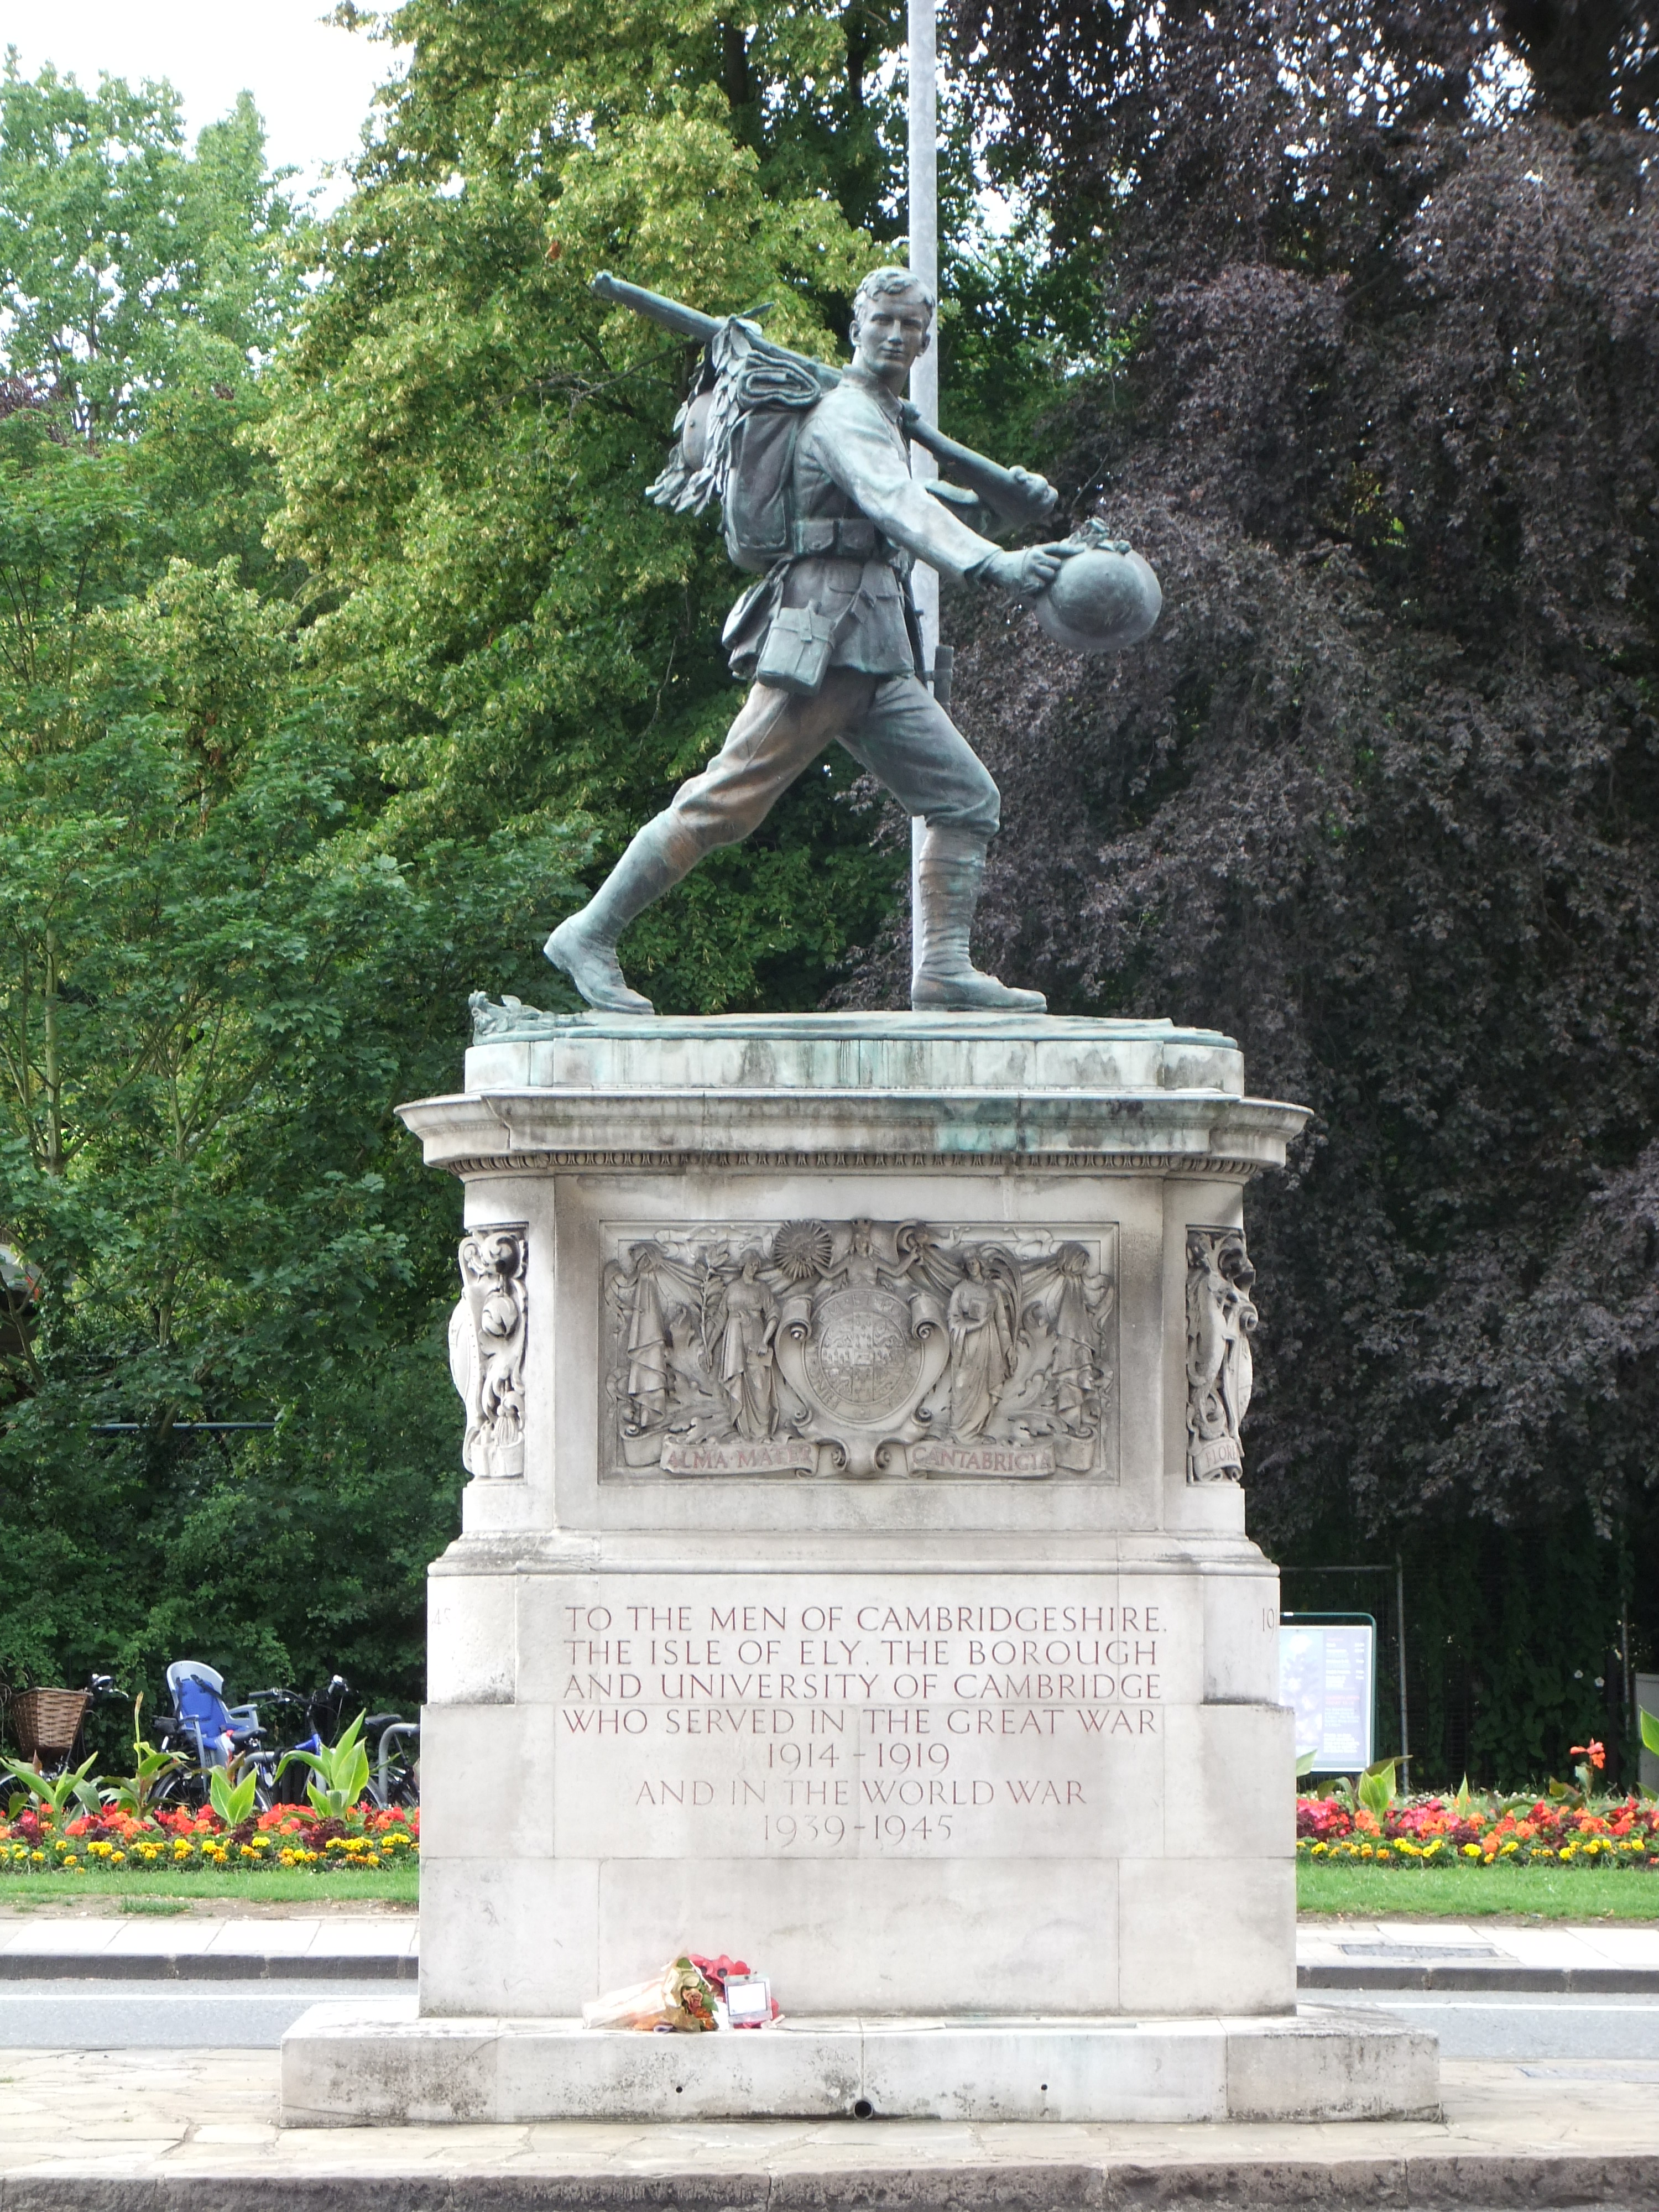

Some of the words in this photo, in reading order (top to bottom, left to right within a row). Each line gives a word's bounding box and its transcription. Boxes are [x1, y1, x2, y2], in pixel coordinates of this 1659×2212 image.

[565, 1606, 612, 1631] TO
[627, 1606, 692, 1631] THE
[711, 1606, 786, 1631] MEN
[802, 1606, 843, 1631] OF
[564, 1640, 632, 1665] THE
[651, 1640, 721, 1665] ISLE
[739, 1640, 781, 1665] OF
[881, 1640, 950, 1665] THE
[969, 1640, 1156, 1665] BOROUGH
[564, 1674, 641, 1699] AND
[662, 1674, 879, 1699] UNIVERSITY
[894, 1674, 938, 1699] OF
[954, 1674, 1160, 1699] CAMBRIDGE
[563, 1709, 648, 1734] WHO
[666, 1709, 794, 1734] SERVED
[811, 1709, 844, 1734] IN
[863, 1709, 930, 1734] THE
[947, 1709, 1065, 1734] GREAT
[1076, 1709, 1157, 1734] WAR
[636, 1780, 714, 1805] AND
[732, 1780, 766, 1805] IN
[784, 1780, 848, 1805] THE
[862, 1780, 994, 1805] WORLD
[1007, 1780, 1087, 1805] WAR
